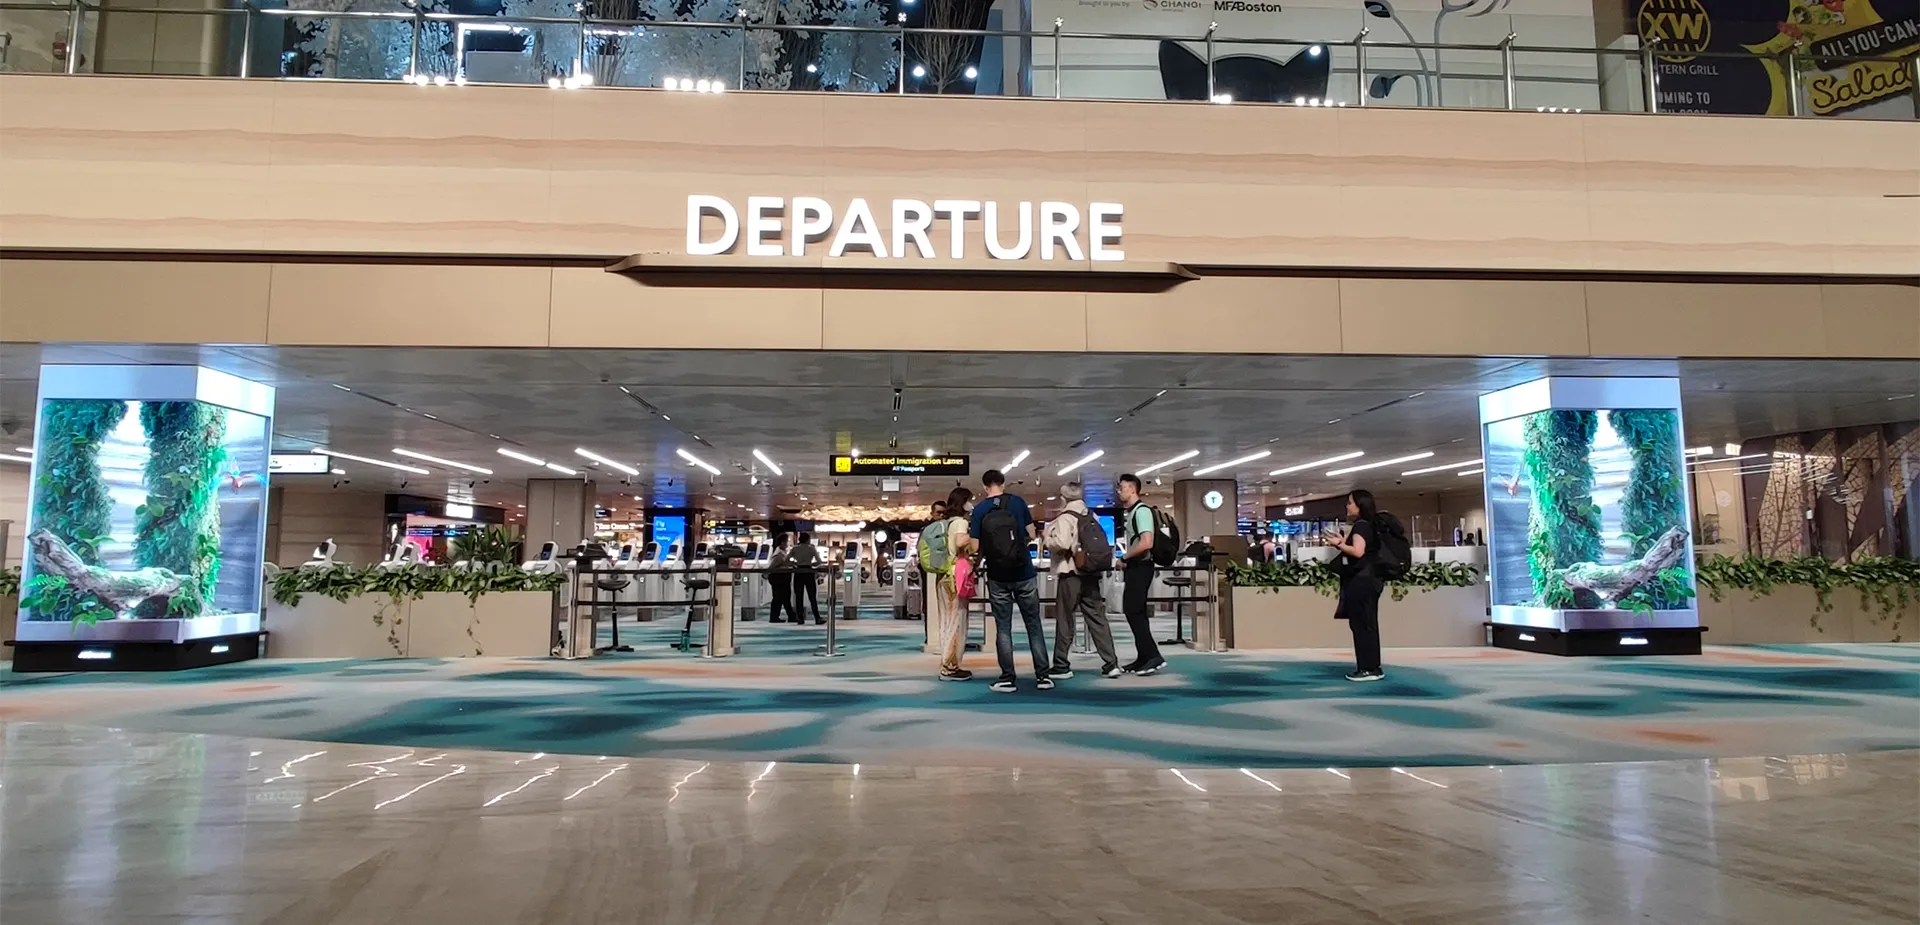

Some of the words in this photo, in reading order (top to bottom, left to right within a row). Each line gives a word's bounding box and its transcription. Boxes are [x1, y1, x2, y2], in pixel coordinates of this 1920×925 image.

[1643, 12, 1704, 39] XW
[1689, 64, 1720, 75] GRILL
[1656, 91, 1693, 104] OMING
[1696, 91, 1711, 105] TO
[686, 194, 1125, 262] DEPARTURE
[853, 457, 895, 465] Automated
[896, 457, 942, 466] Immigration
